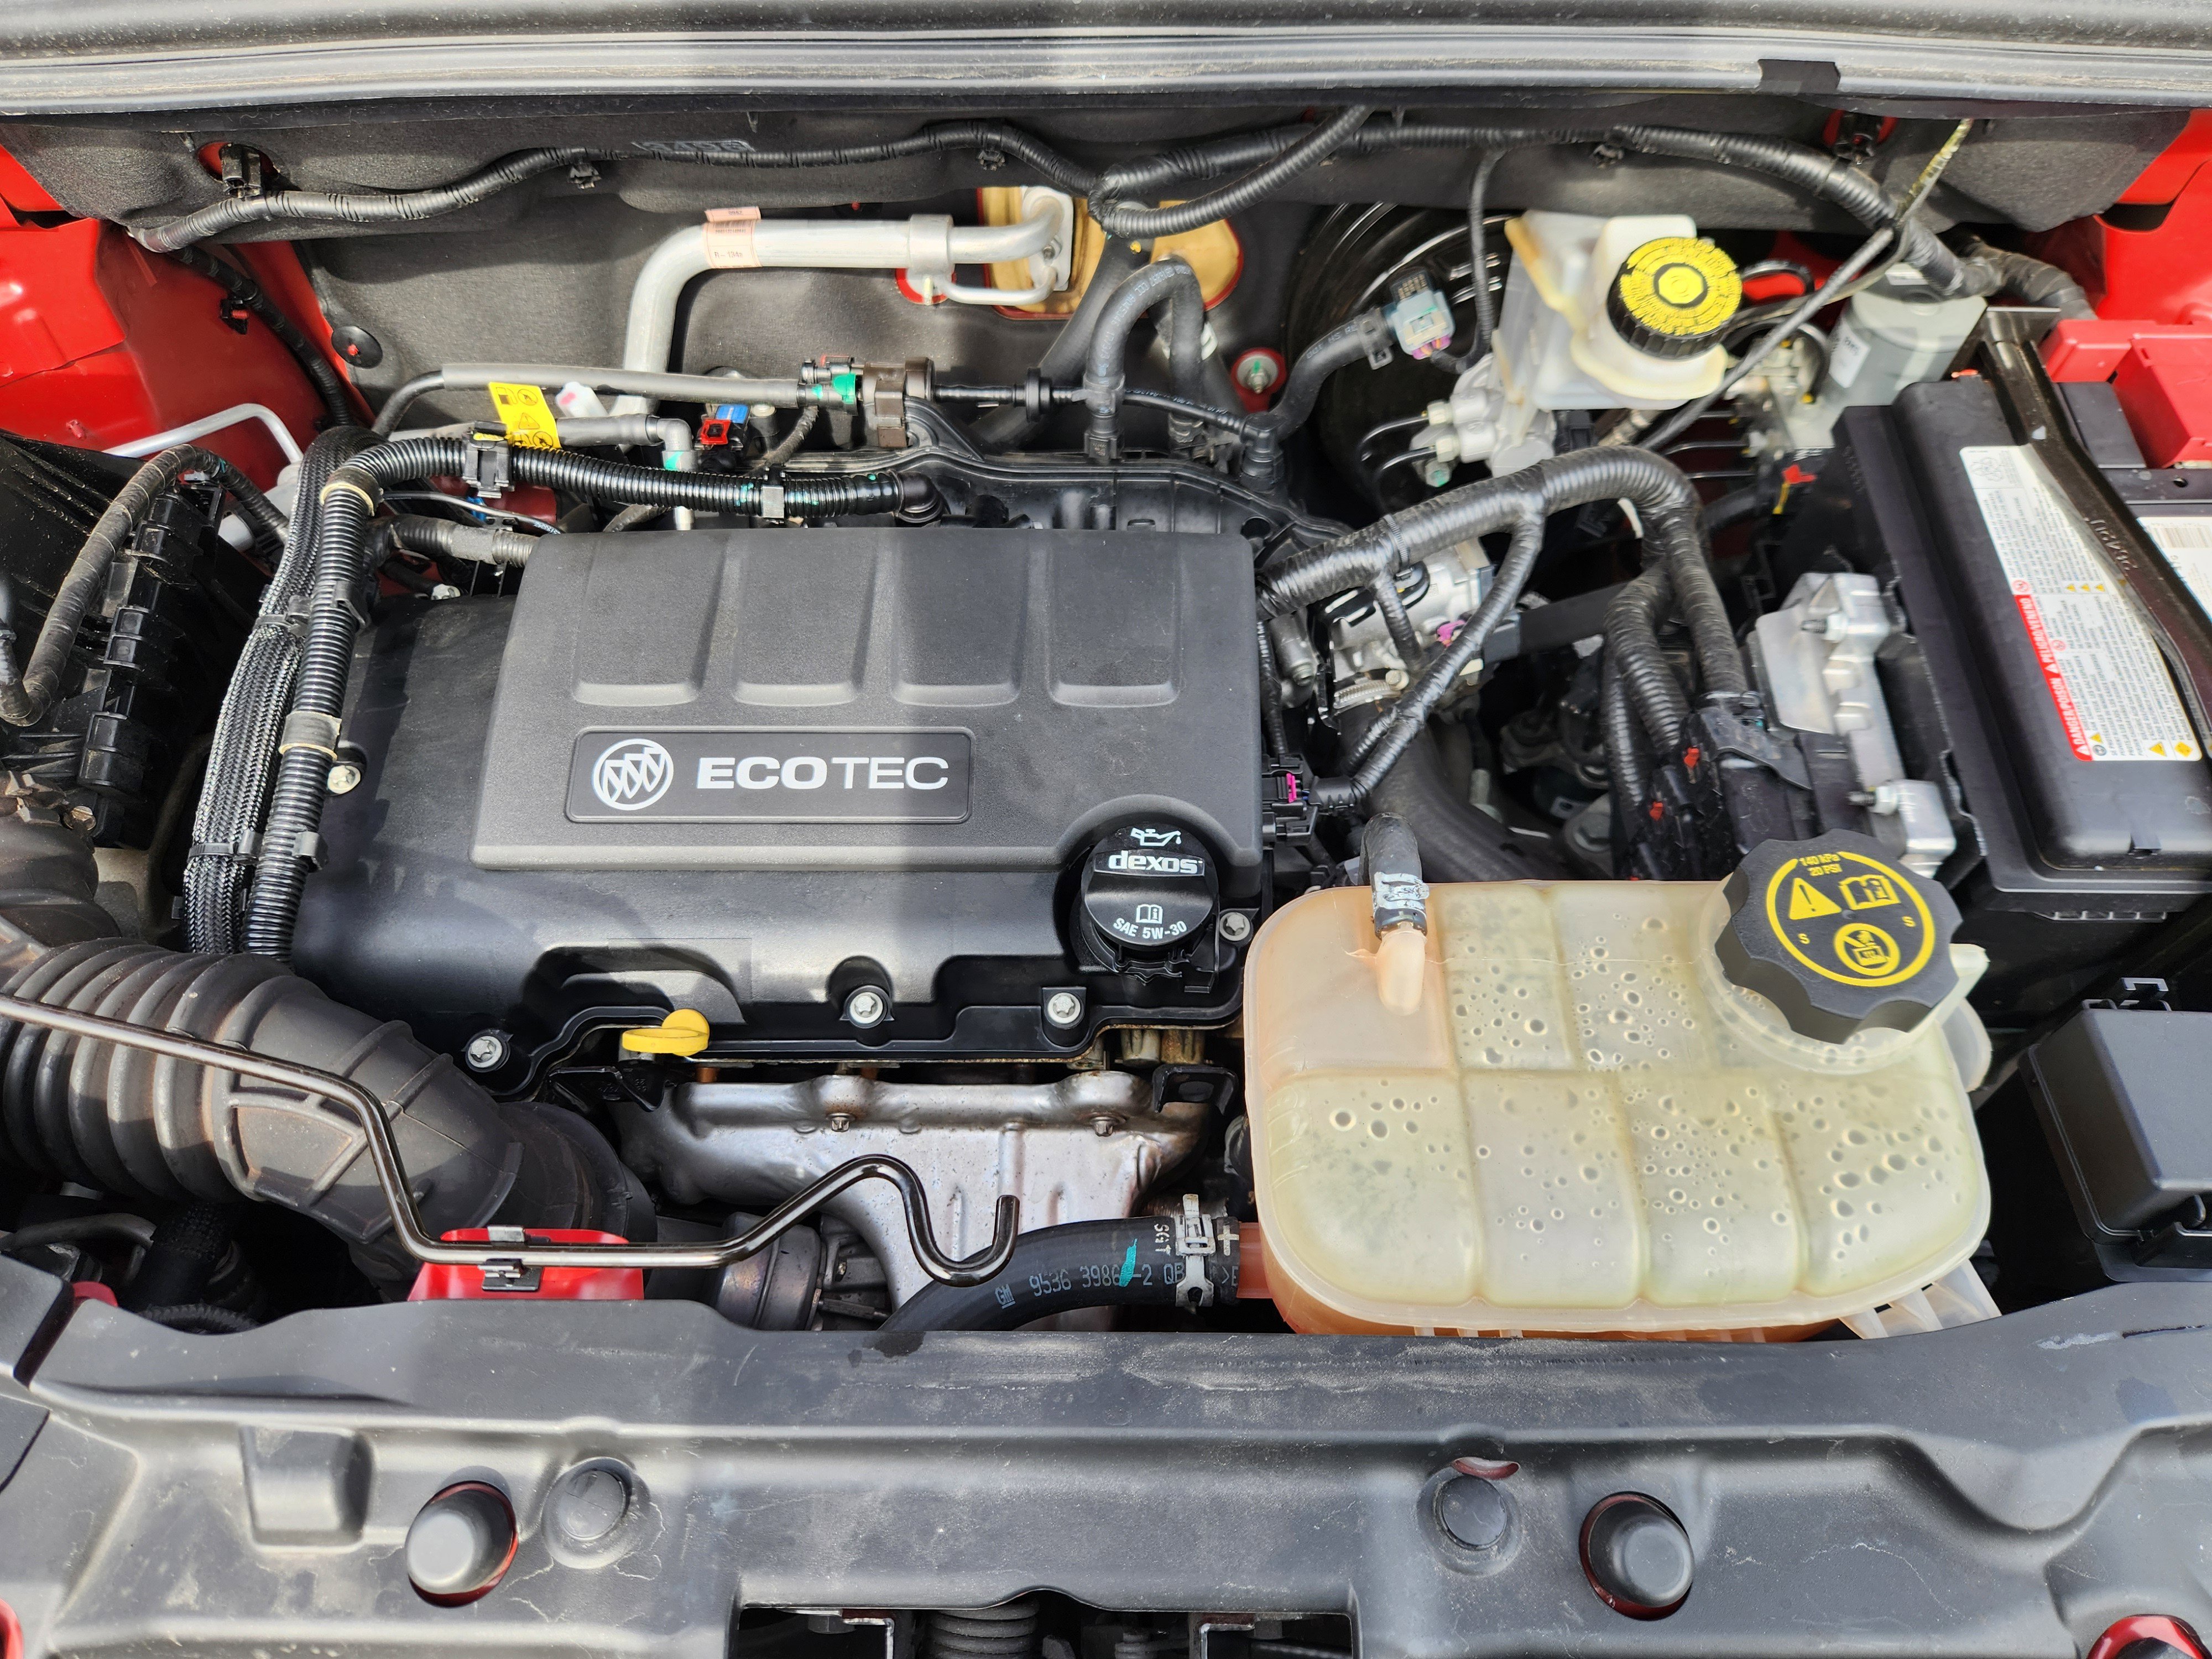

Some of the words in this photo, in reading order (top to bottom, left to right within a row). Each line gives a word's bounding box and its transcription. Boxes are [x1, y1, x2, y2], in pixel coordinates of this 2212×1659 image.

[2048, 677, 2085, 745] DANGER/POISON
[696, 757, 949, 790] ECOTEC
[1108, 850, 1198, 874] dexos
[1807, 866, 1824, 877] 20
[1821, 863, 1843, 874] PSI
[1113, 917, 1139, 937] SAE
[1142, 920, 1187, 940] 5W-30
[1029, 1269, 1072, 1297] 9536
